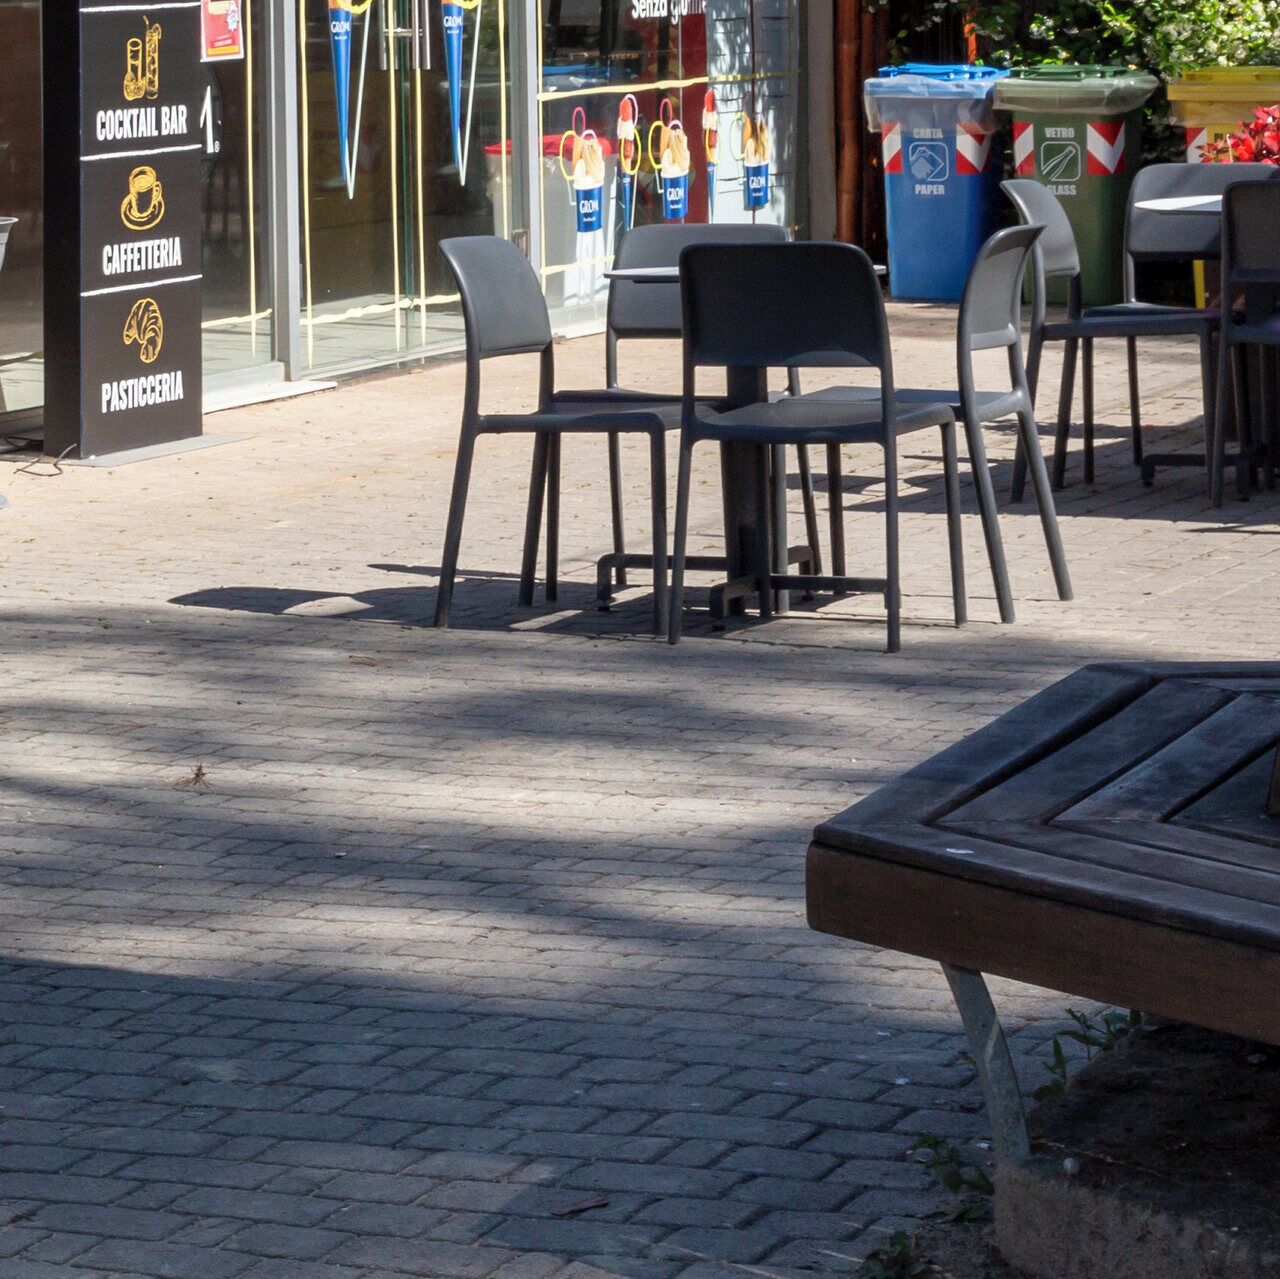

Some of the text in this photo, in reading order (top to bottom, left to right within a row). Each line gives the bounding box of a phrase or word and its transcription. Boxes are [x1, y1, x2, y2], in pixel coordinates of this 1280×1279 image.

[96, 106, 159, 141] COCKTAIL
[161, 104, 188, 136] BAR
[1045, 127, 1075, 138] VETRO
[914, 184, 945, 195] PAPER
[102, 236, 183, 276] CAFFETTERIA
[101, 370, 184, 414] PASTICCERIA
